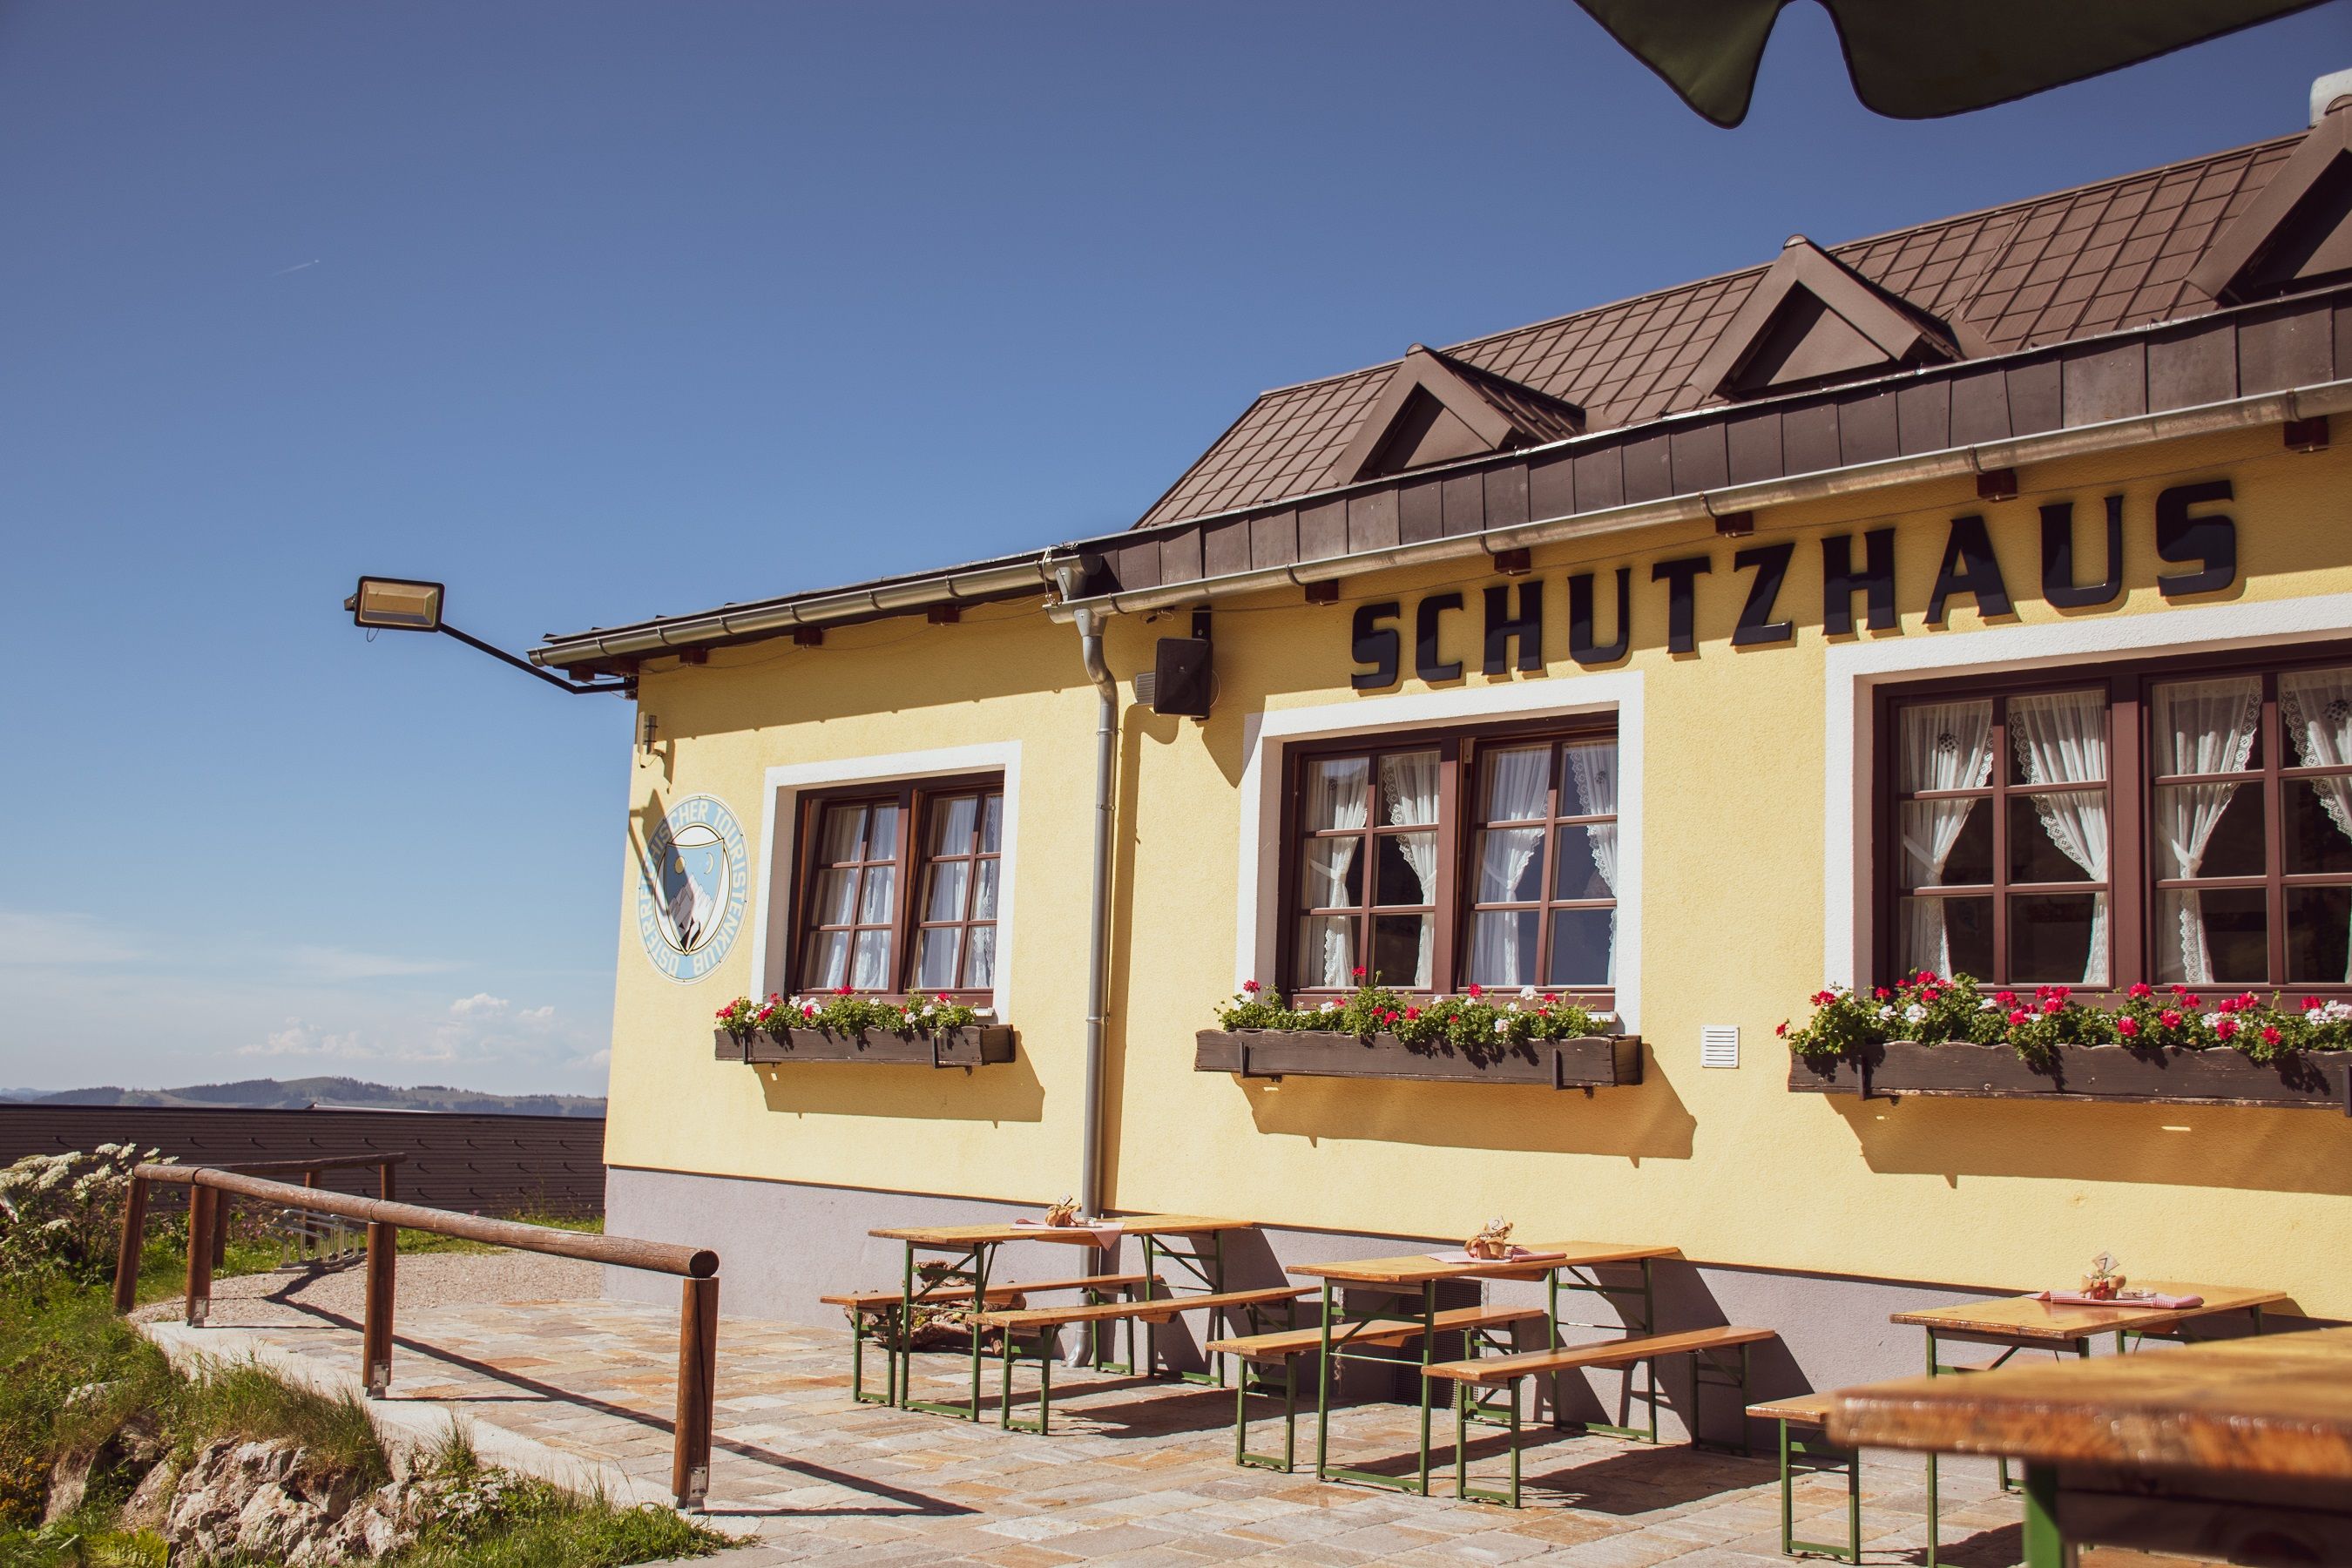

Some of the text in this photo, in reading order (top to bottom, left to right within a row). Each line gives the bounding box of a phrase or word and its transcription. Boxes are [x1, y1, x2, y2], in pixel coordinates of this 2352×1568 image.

[1351, 480, 2237, 690] SCHUTZHAUS
[693, 808, 747, 976] TOURISTENKLUB
[1491, 1219, 1500, 1230] 2
